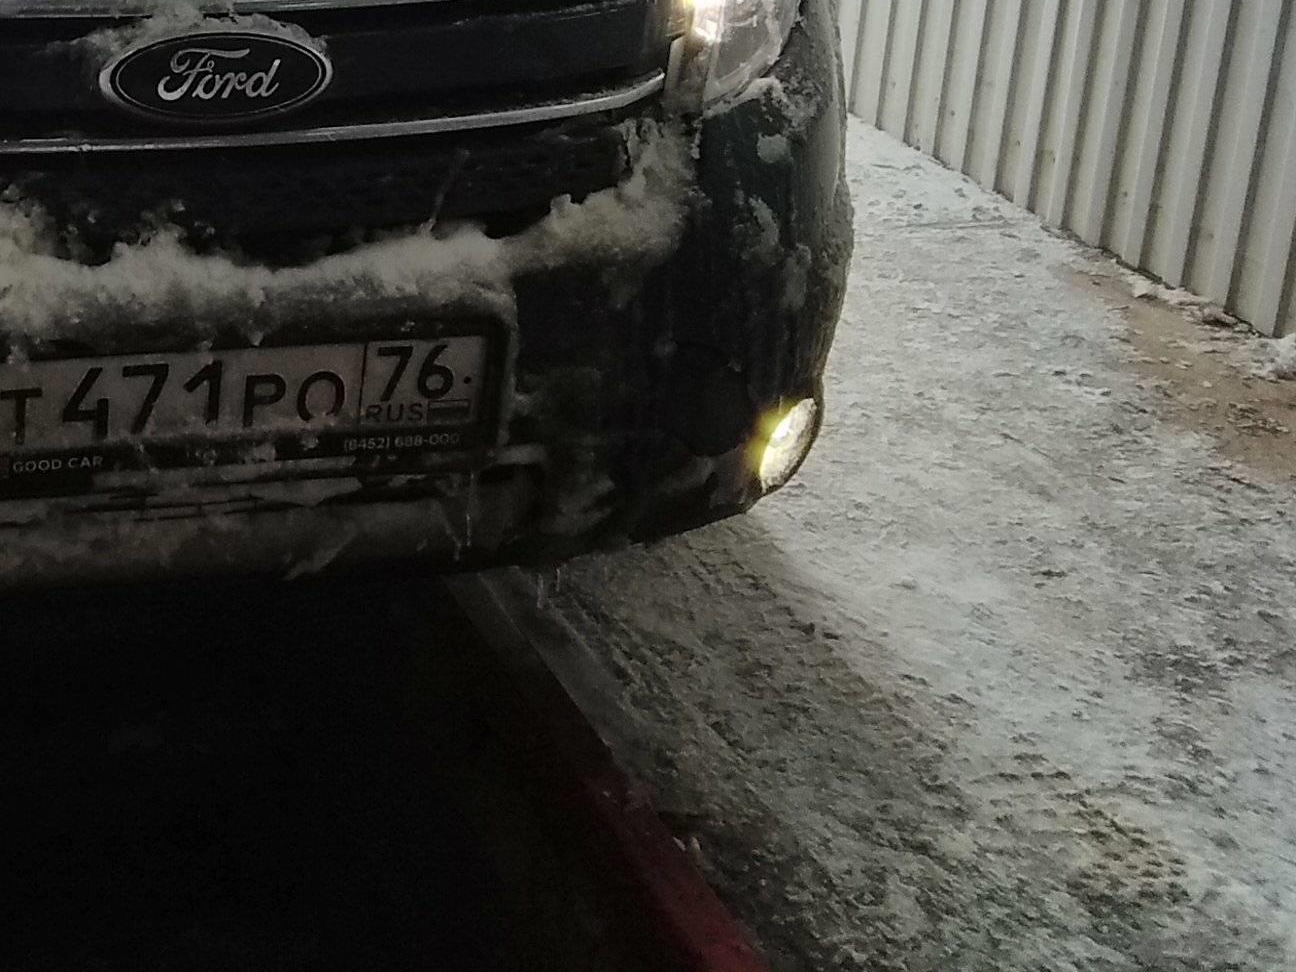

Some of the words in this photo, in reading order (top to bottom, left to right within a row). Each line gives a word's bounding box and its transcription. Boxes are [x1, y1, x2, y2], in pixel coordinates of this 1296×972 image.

[157, 47, 281, 101] Ford
[377, 344, 454, 402] 76
[366, 402, 424, 423] RUS
[12, 458, 62, 473] GOOD
[68, 455, 104, 469] CAR
